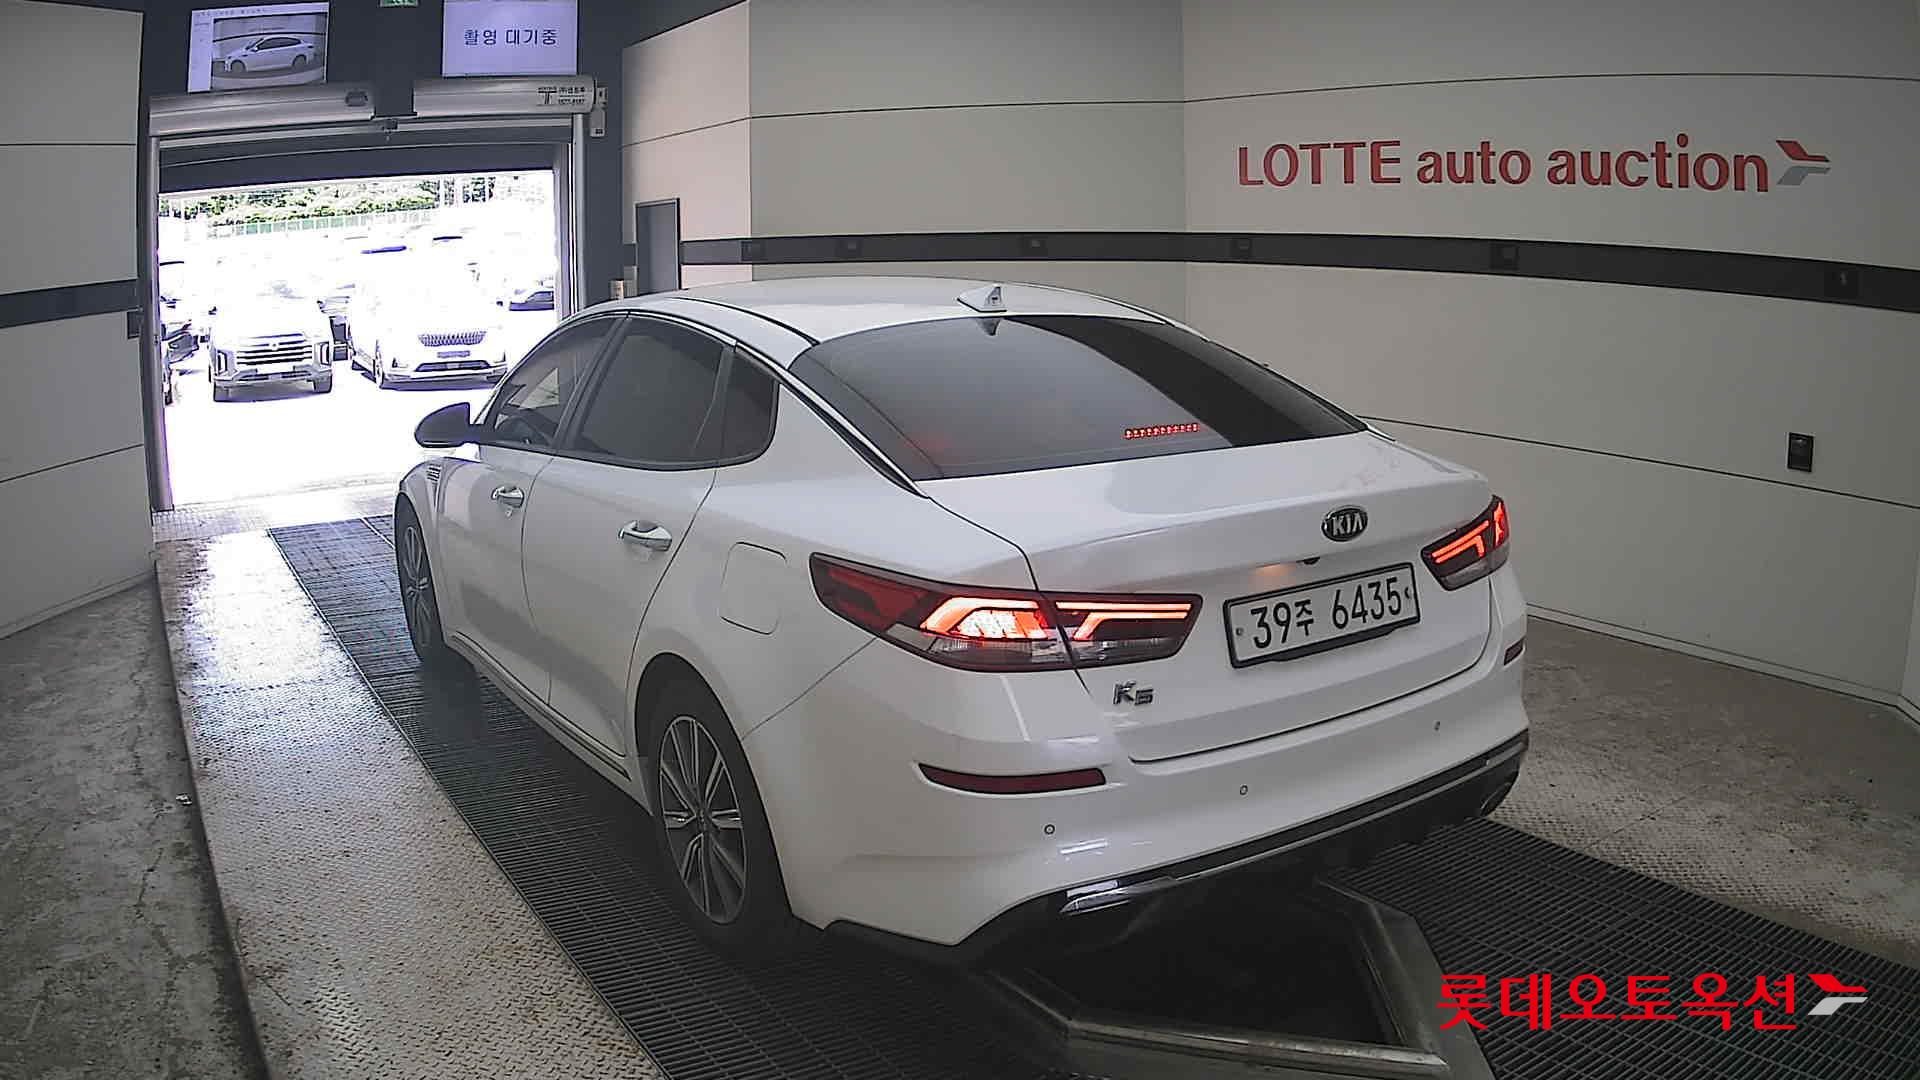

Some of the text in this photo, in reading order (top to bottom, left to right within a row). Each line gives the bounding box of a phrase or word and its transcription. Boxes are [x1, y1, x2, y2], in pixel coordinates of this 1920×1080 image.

[505, 28, 557, 46] 대기중
[1238, 133, 1769, 193] LOTTE auto auction
[1331, 511, 1364, 537] KIA
[1251, 577, 1402, 649] 39주 6435
[1112, 681, 1154, 706] K5
